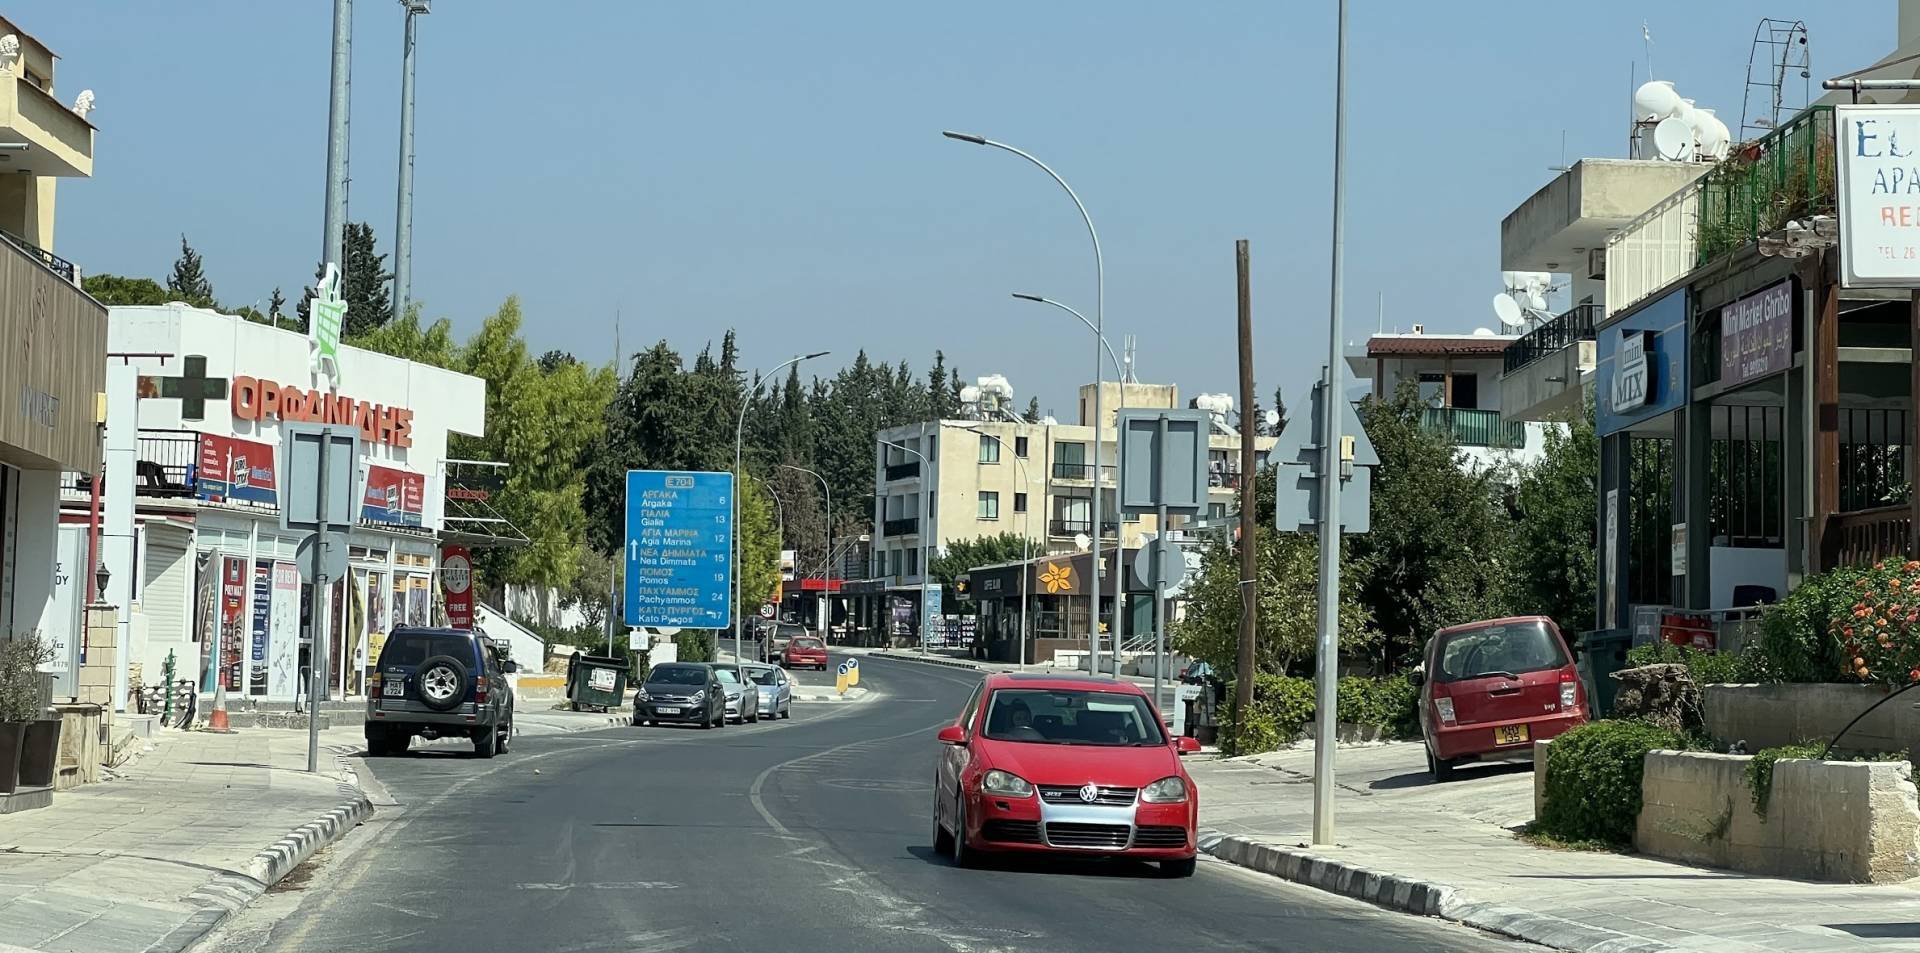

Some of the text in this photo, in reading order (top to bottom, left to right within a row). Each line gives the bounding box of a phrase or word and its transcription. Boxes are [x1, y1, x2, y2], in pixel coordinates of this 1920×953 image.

[1881, 206, 1920, 227] RE
[1723, 288, 1790, 337] Mini Market Ghribo
[1624, 338, 1642, 364] mini
[1615, 370, 1643, 406] MIX
[676, 478, 692, 486] 704
[642, 491, 678, 499] ΑΡΓΑΚΑ
[642, 500, 672, 508] Argaka
[641, 518, 664, 526] Gialia
[642, 528, 699, 537] ΑΓΙΑ ΜΑΡΙΝΑ
[642, 534, 724, 546] Agia Marina 12
[640, 548, 707, 558] ΝΕΑ ΔΗΜΜΑΤΑ
[640, 554, 724, 566] Nea Dimmata 15
[640, 568, 674, 576] ΠΟΜΟΣ
[640, 574, 724, 584] Pomos 19
[640, 587, 699, 596] ΠΑΧΥΑΜΜΟΣ
[639, 592, 723, 605] Pachyammos 24
[449, 604, 467, 612] FREE
[639, 606, 704, 616] ΚΑΤΟ ΠΥΡΓΟΣ
[762, 605, 772, 614] 30
[638, 615, 658, 623] Kato
[1080, 786, 1098, 802] VW
